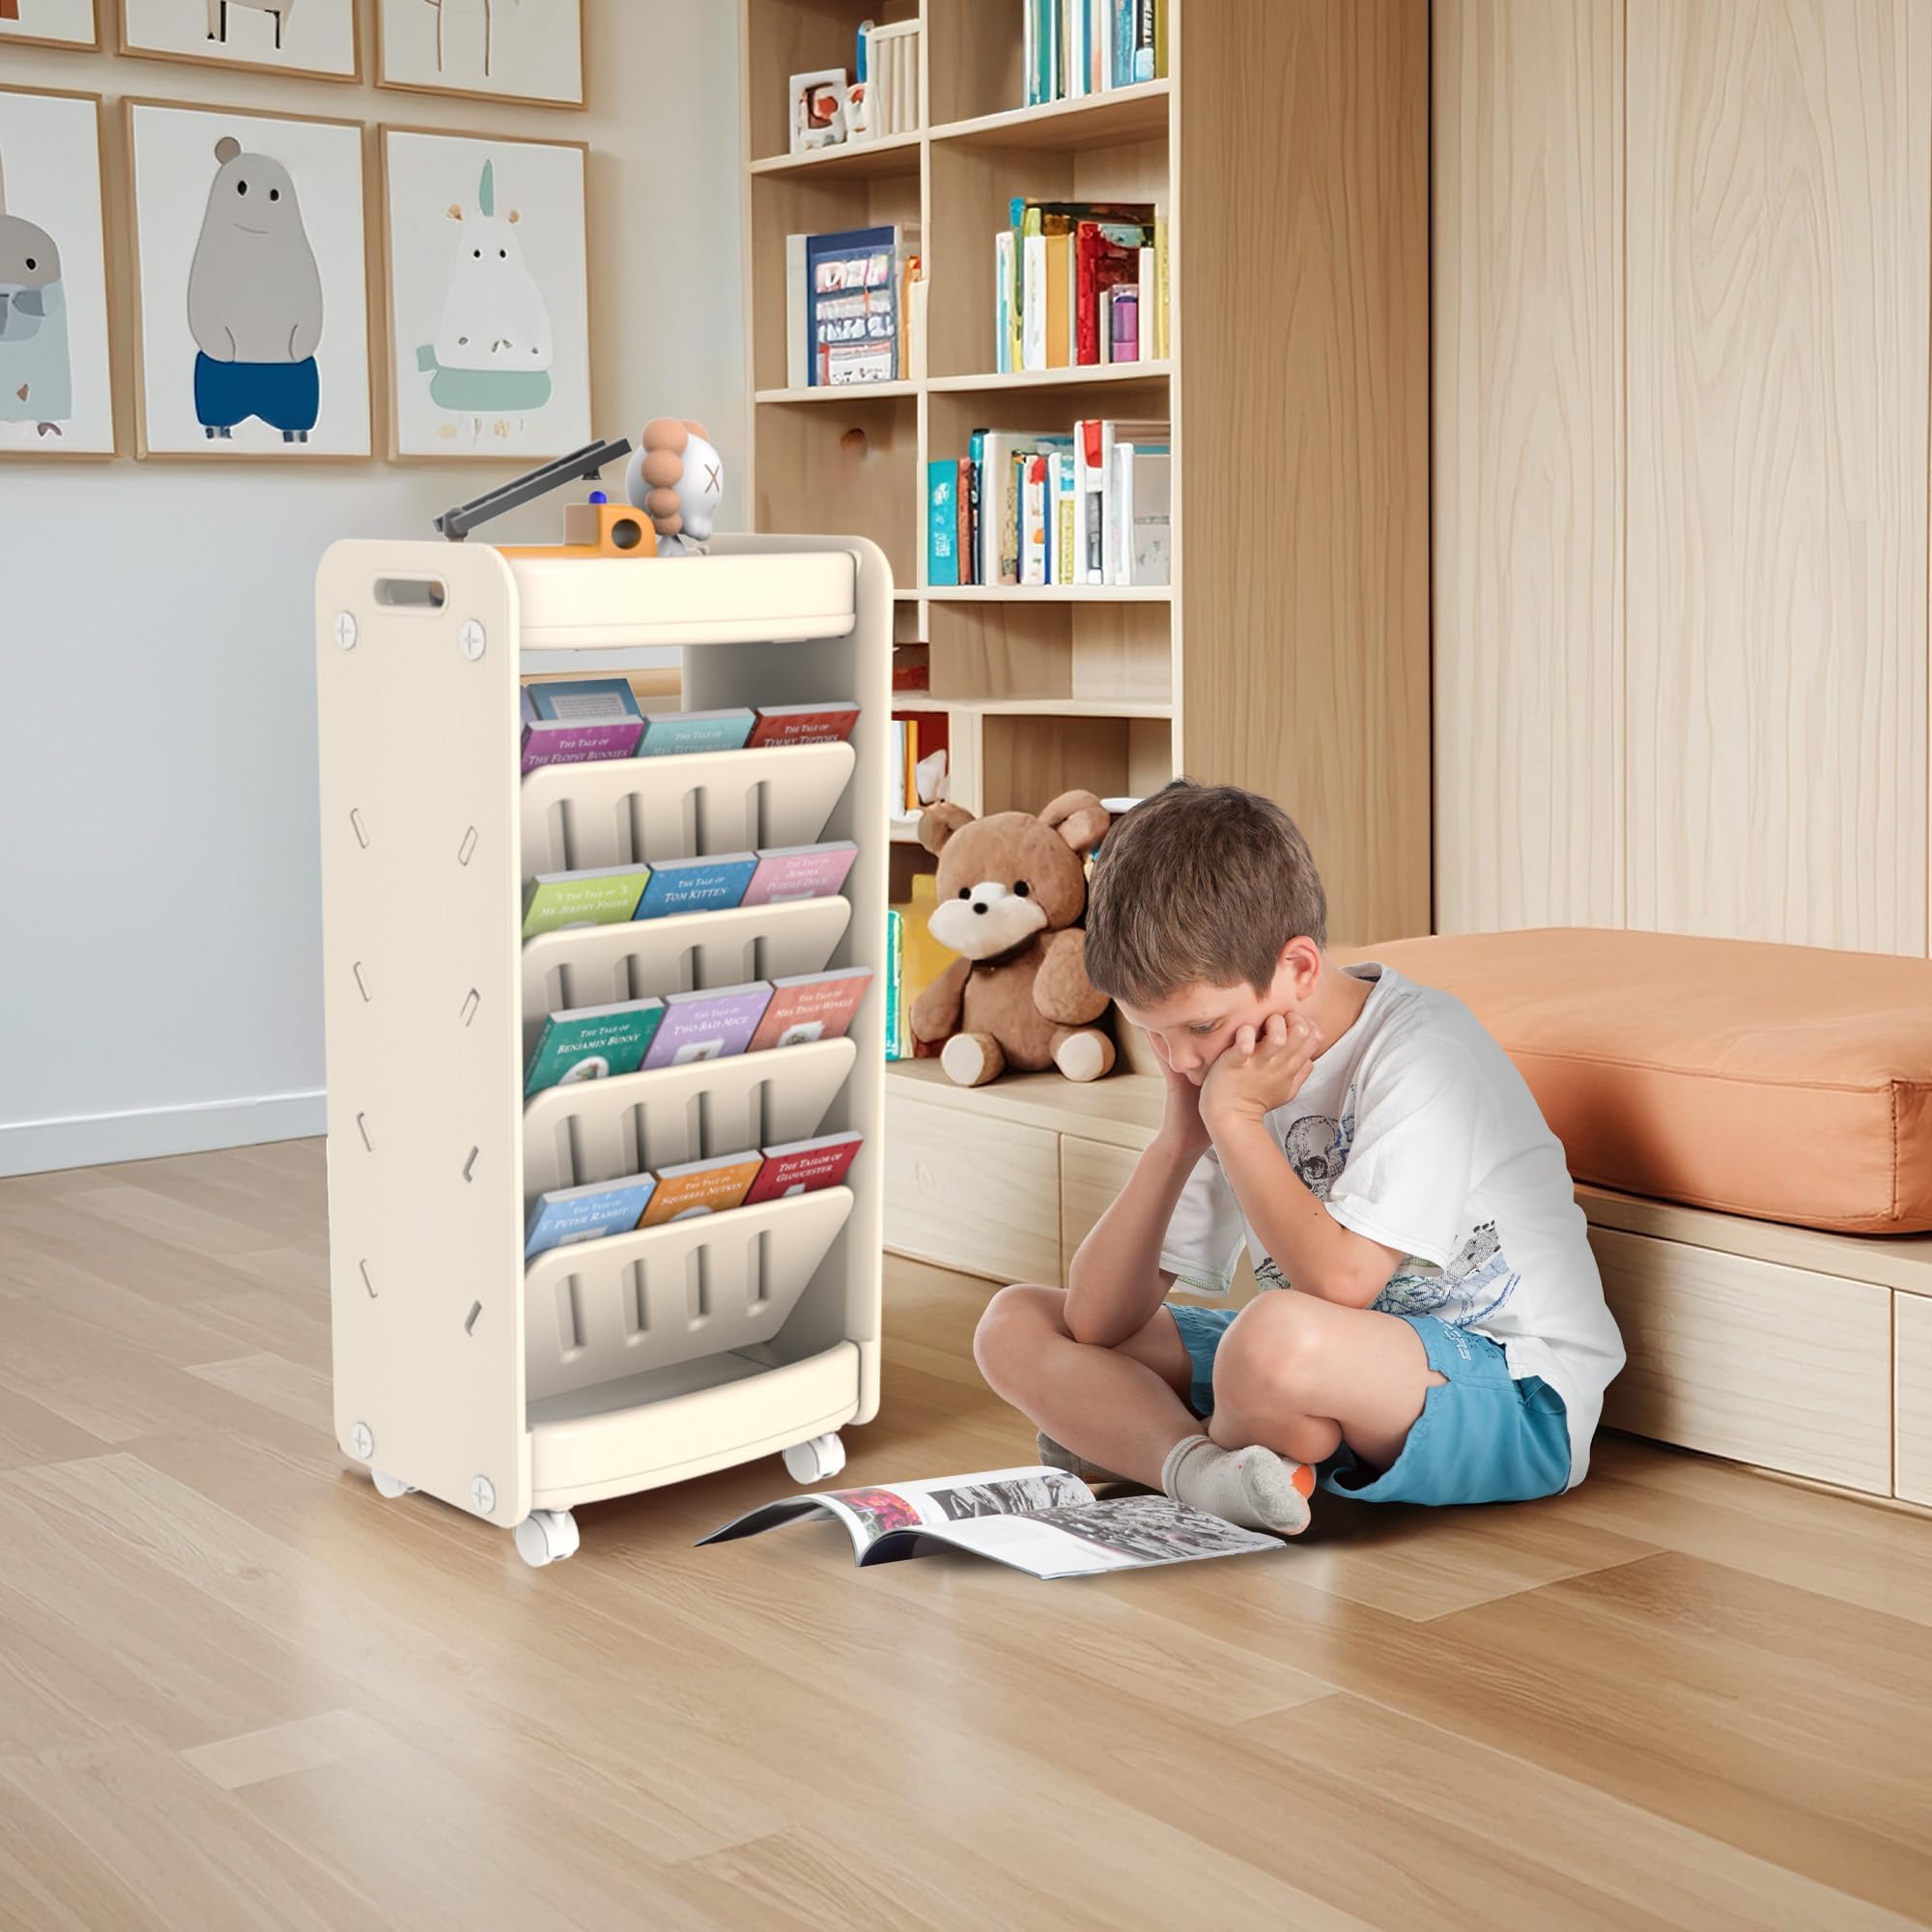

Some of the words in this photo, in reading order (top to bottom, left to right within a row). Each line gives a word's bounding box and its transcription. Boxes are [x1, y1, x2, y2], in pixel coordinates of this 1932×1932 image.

[784, 725, 800, 735] THE
[559, 740, 577, 750] THE
[578, 738, 598, 748] TALE
[528, 754, 551, 766] THE
[551, 753, 586, 764] FLOPSY
[587, 749, 629, 760] BUNNIES
[678, 879, 694, 889] THE
[696, 877, 714, 887] TALE
[665, 892, 688, 903] TOM
[688, 888, 727, 900] KITTEN
[581, 1029, 598, 1038] THE
[599, 1026, 618, 1036] TALE
[618, 1023, 632, 1032] OF
[673, 1024, 698, 1037] TWO
[698, 1020, 721, 1033] BAD
[721, 1015, 749, 1029] MICE
[556, 1038, 608, 1055] BENJAMIN
[607, 1033, 641, 1046] BUNNY
[779, 1161, 800, 1173] THE
[799, 1154, 832, 1168] TAILOR
[831, 1152, 843, 1162] OF
[776, 1164, 834, 1183] GLOUCESTER
[660, 1190, 705, 1206] SQUIRREL
[706, 1181, 743, 1197] NUTKIN
[554, 1217, 587, 1230] PETER
[588, 1207, 630, 1223] RABBIT
